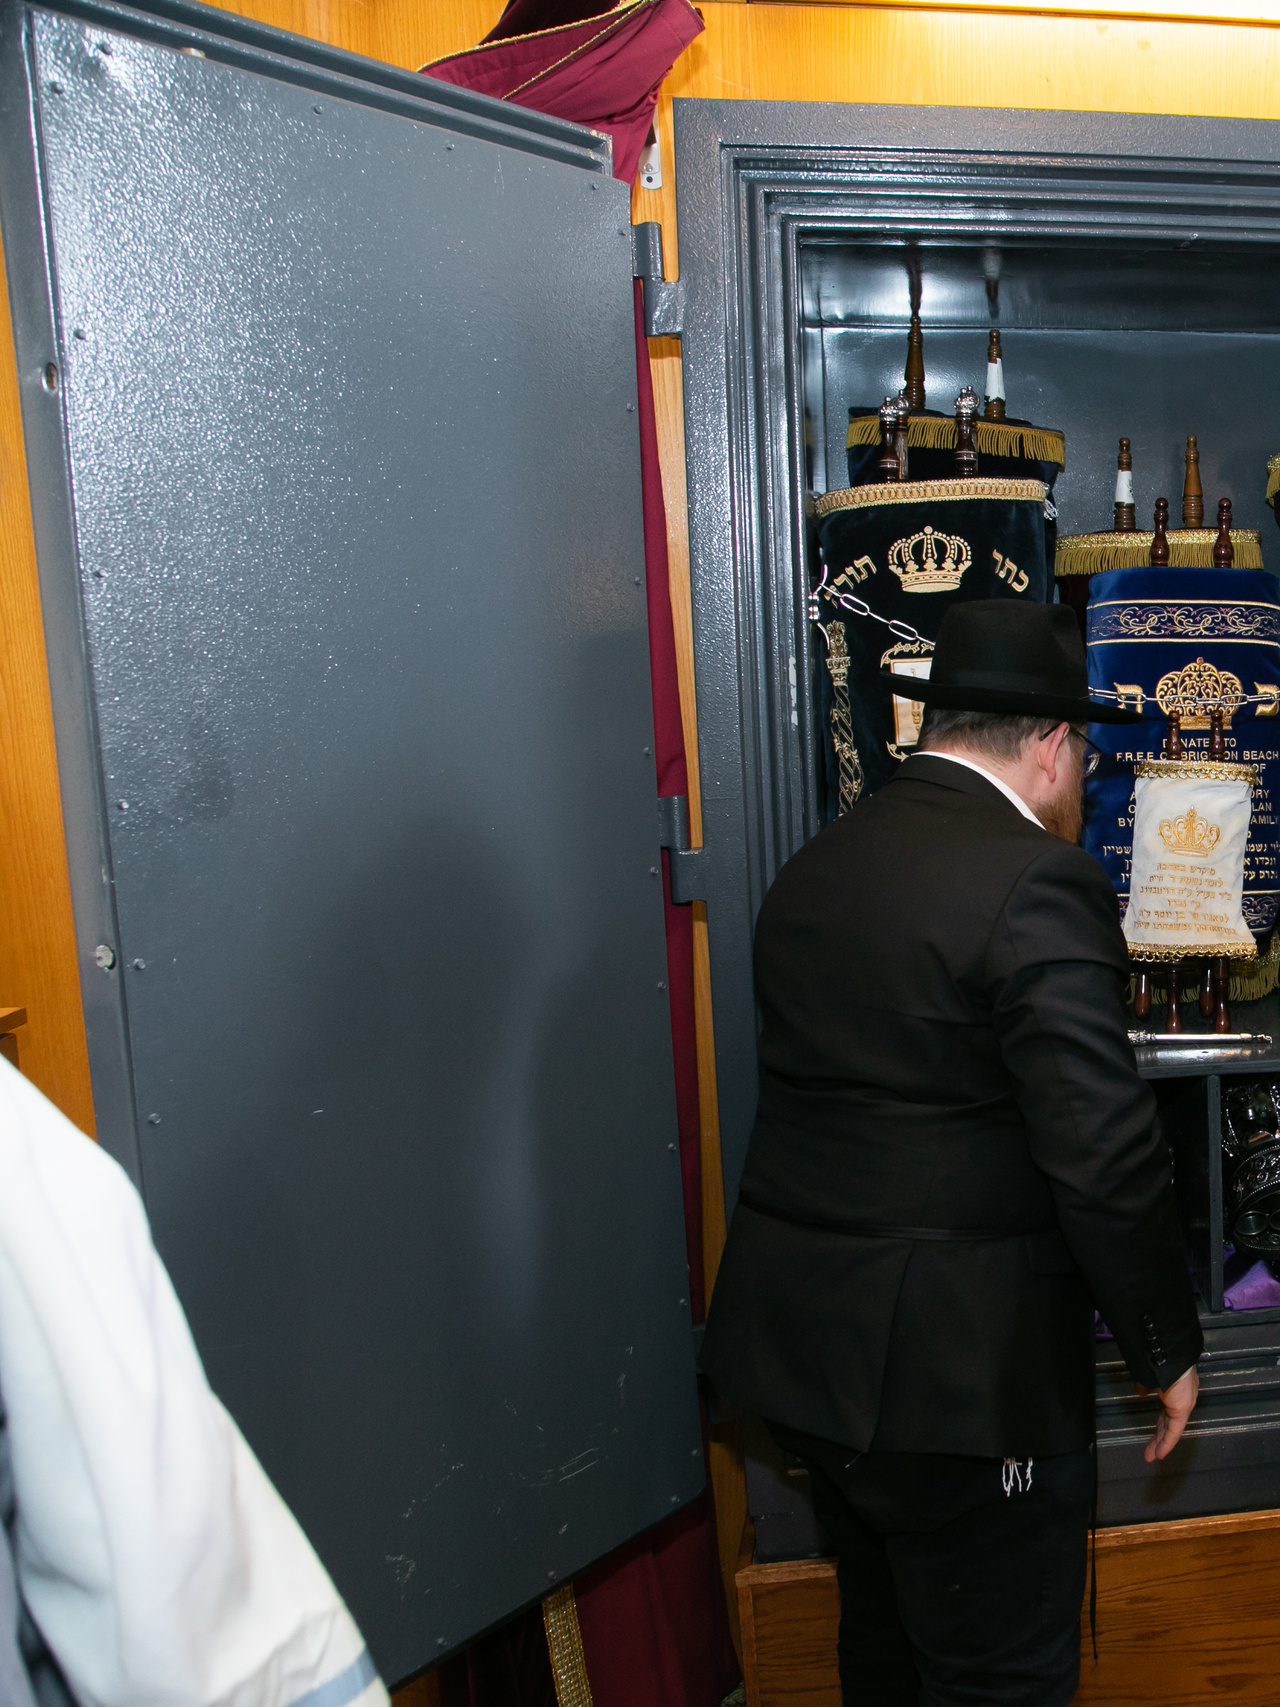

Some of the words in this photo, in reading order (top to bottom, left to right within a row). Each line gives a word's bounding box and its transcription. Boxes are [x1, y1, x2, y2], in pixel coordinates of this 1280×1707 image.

[991, 548, 1030, 592] כתר
[1163, 738, 1210, 748] DNATE
[1224, 737, 1236, 748] TO
[1180, 750, 1238, 760] BRIGON
[1243, 750, 1279, 760] BEACH
[1118, 817, 1134, 827] BY
[1250, 814, 1280, 825] AMILY
